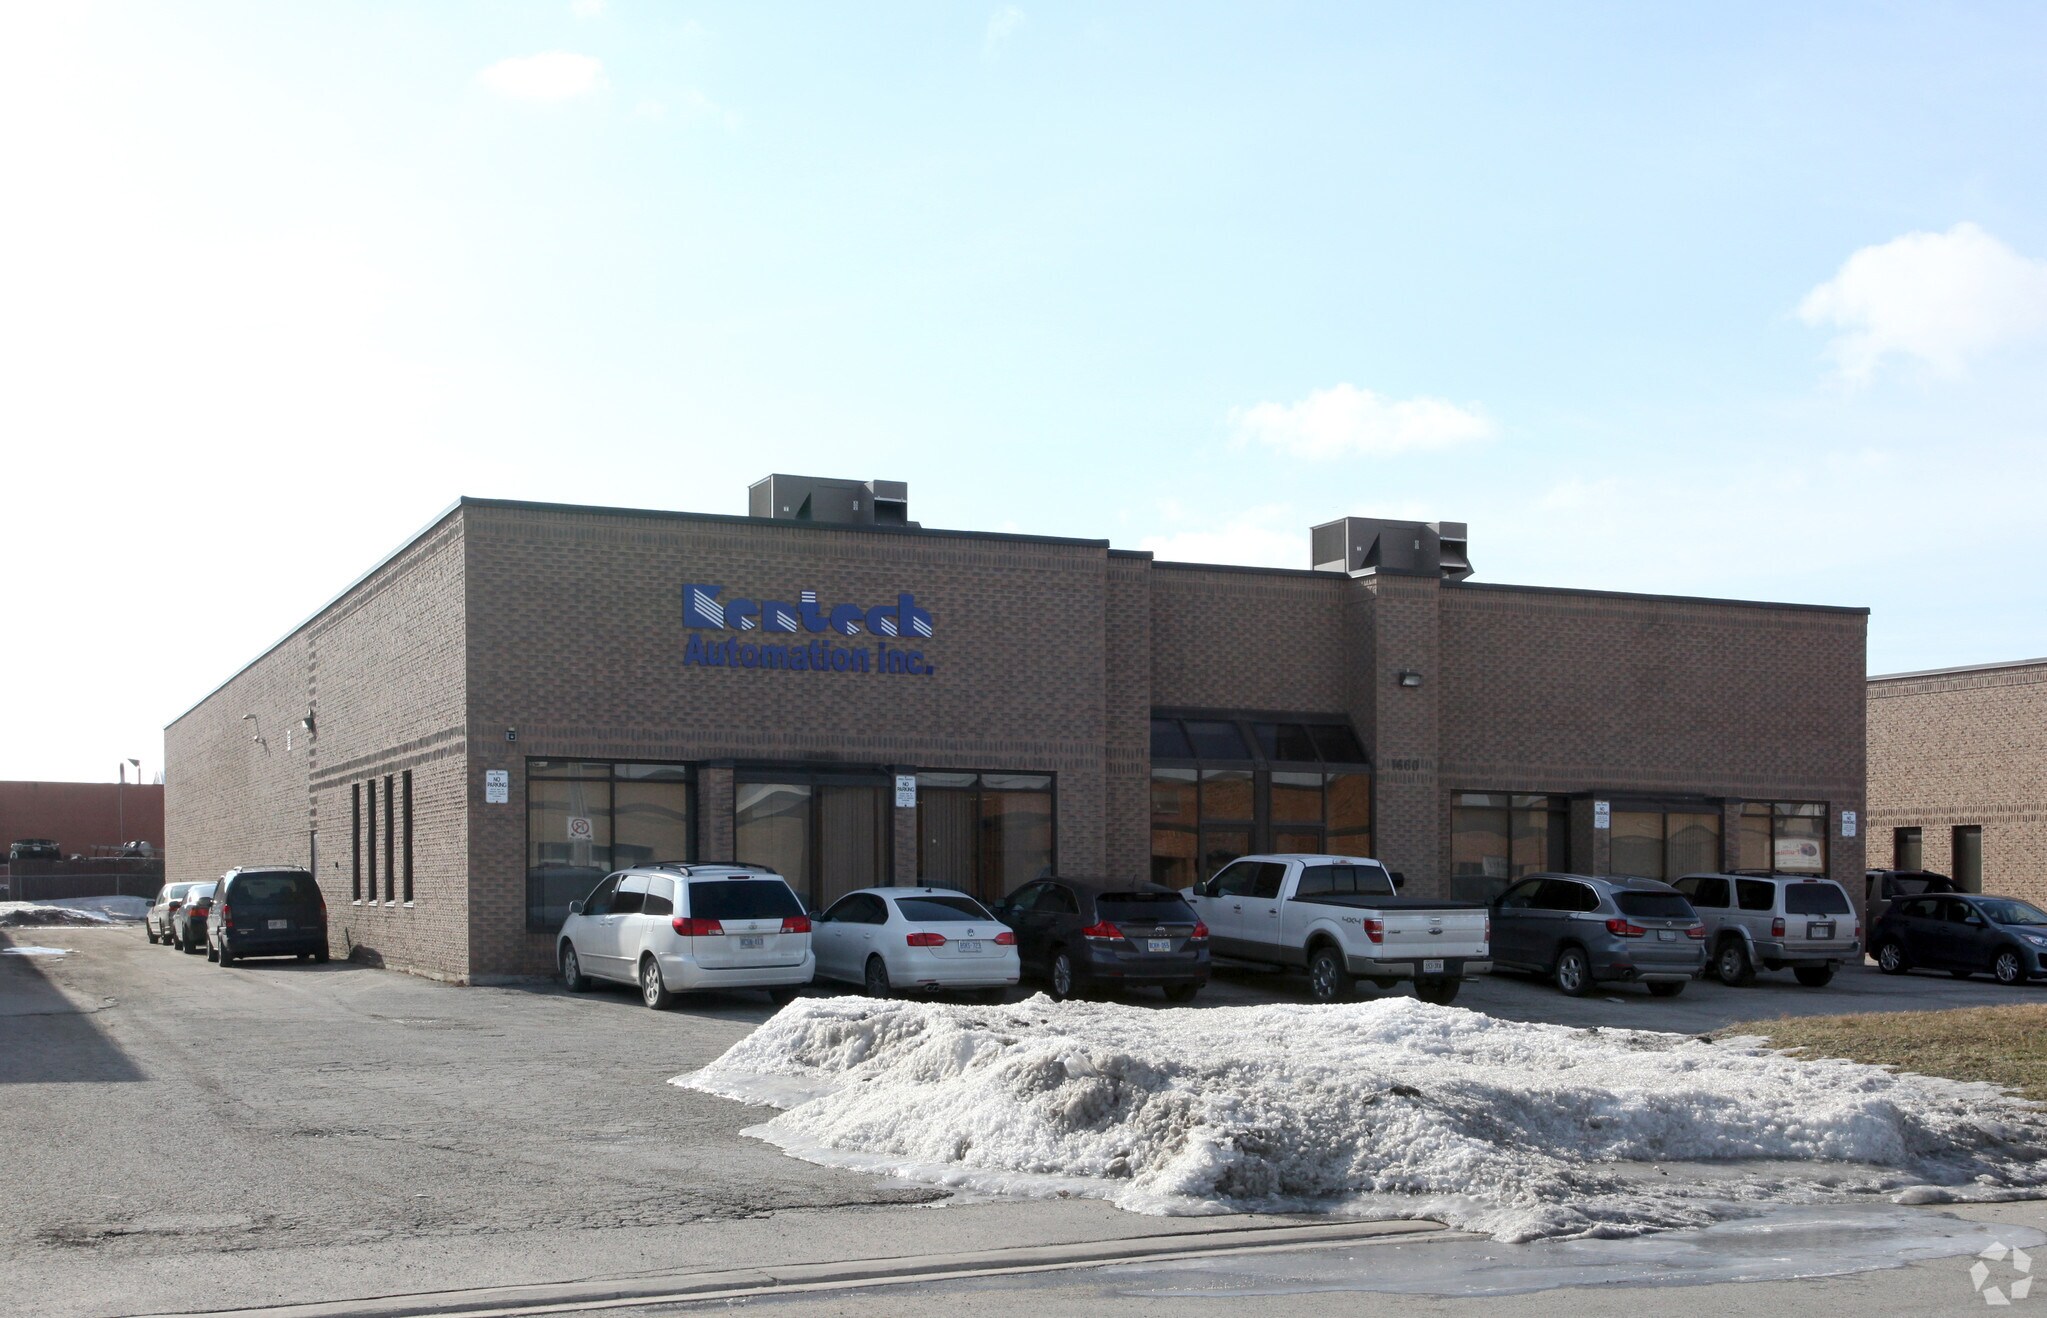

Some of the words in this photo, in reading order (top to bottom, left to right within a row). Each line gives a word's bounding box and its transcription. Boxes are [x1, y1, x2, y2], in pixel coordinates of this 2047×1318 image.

[683, 583, 934, 638] Kentech
[683, 632, 870, 673] Automation
[878, 642, 934, 675] inc.
